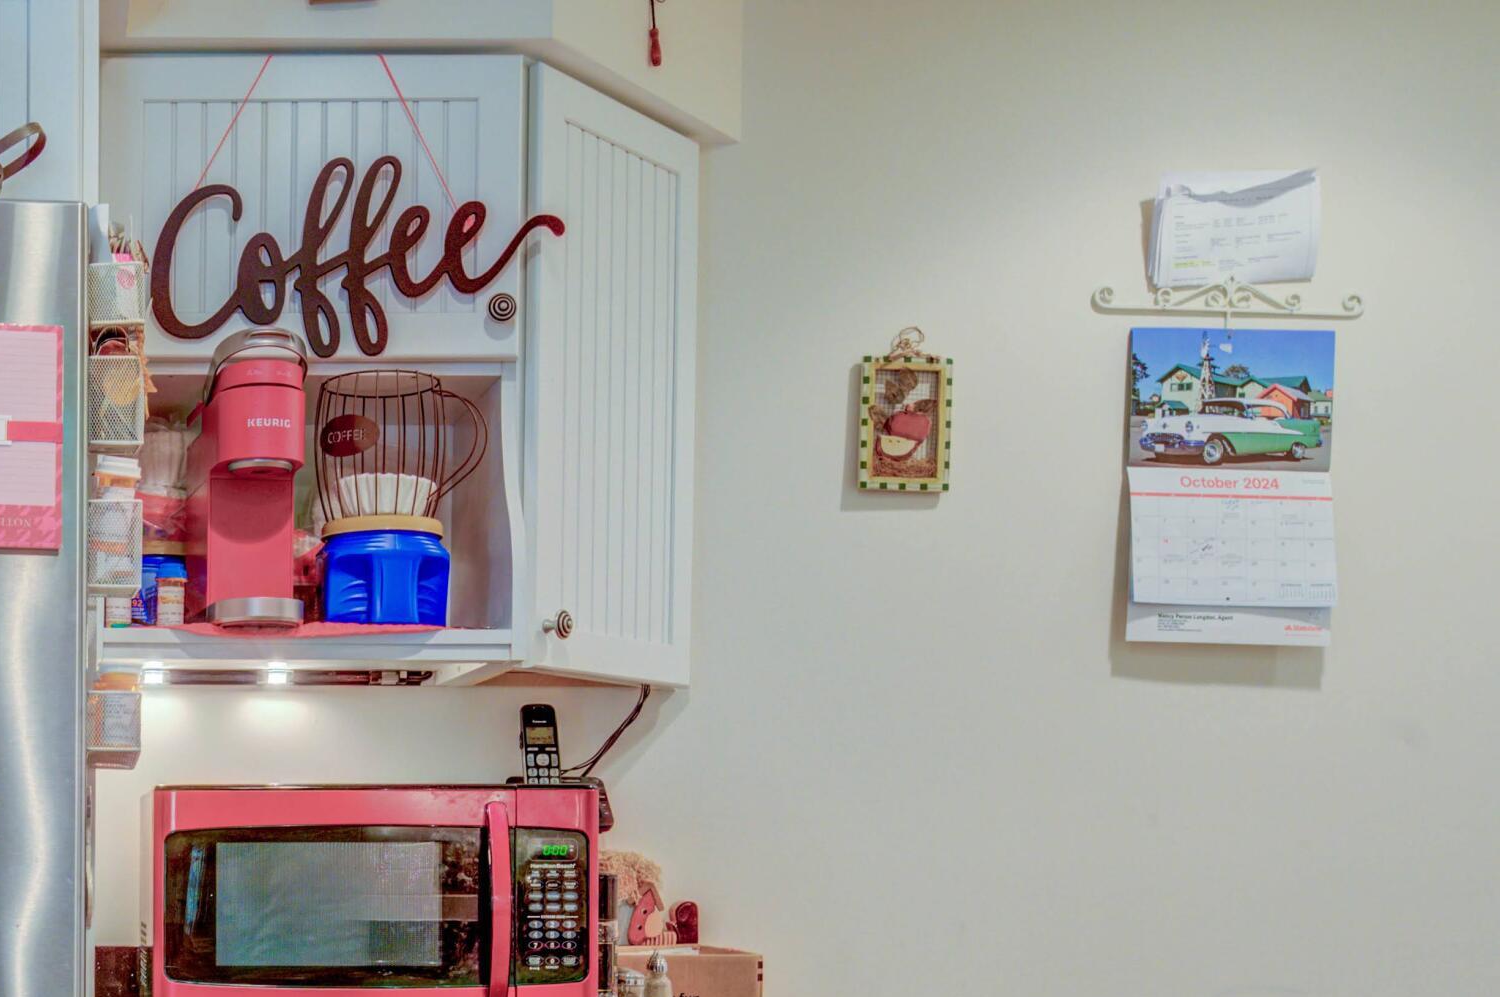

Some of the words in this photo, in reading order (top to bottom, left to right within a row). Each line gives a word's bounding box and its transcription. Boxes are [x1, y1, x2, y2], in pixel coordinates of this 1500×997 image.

[152, 156, 565, 358] Coffee
[247, 418, 291, 428] KEURIG
[328, 428, 366, 444] COFFEE
[1180, 475, 1239, 489] October
[1243, 477, 1280, 490] 2024
[543, 844, 568, 856] 0:00
